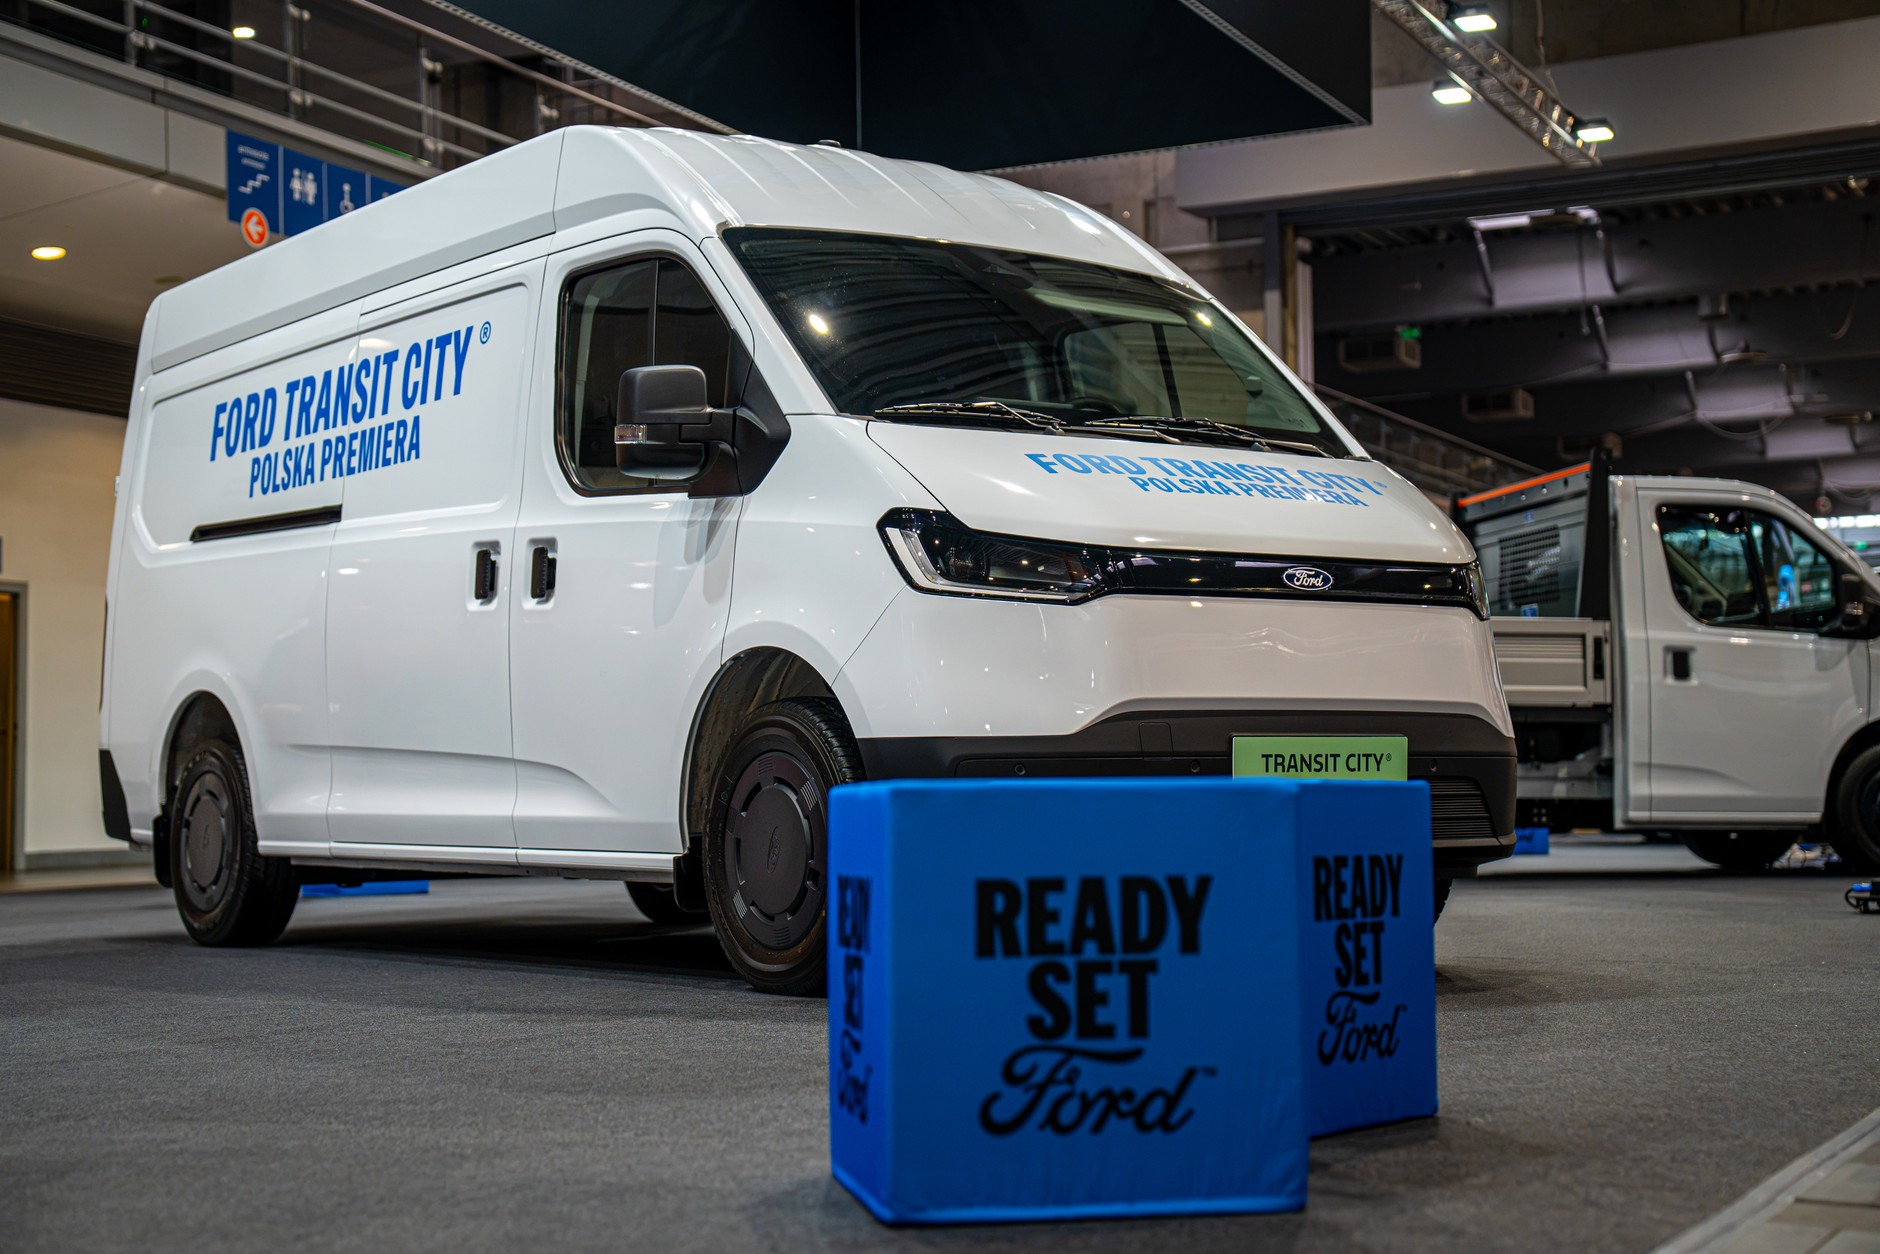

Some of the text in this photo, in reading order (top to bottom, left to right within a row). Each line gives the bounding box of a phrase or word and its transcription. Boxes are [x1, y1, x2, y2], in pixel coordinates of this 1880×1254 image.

[210, 387, 277, 462] FORD
[283, 349, 399, 441] TRANSIT
[249, 415, 420, 498] POLSKA PREMIERA
[1024, 453, 1146, 475] FORD
[1138, 456, 1302, 486] TRANSIT
[1127, 476, 1369, 507] POLSKA PREMIERA
[1294, 570, 1324, 587] Ford
[1261, 753, 1341, 773] TRANSIT
[975, 875, 1213, 960] READY
[1313, 854, 1404, 922] READY
[1335, 920, 1385, 989] SET
[1026, 958, 1159, 1041] SET
